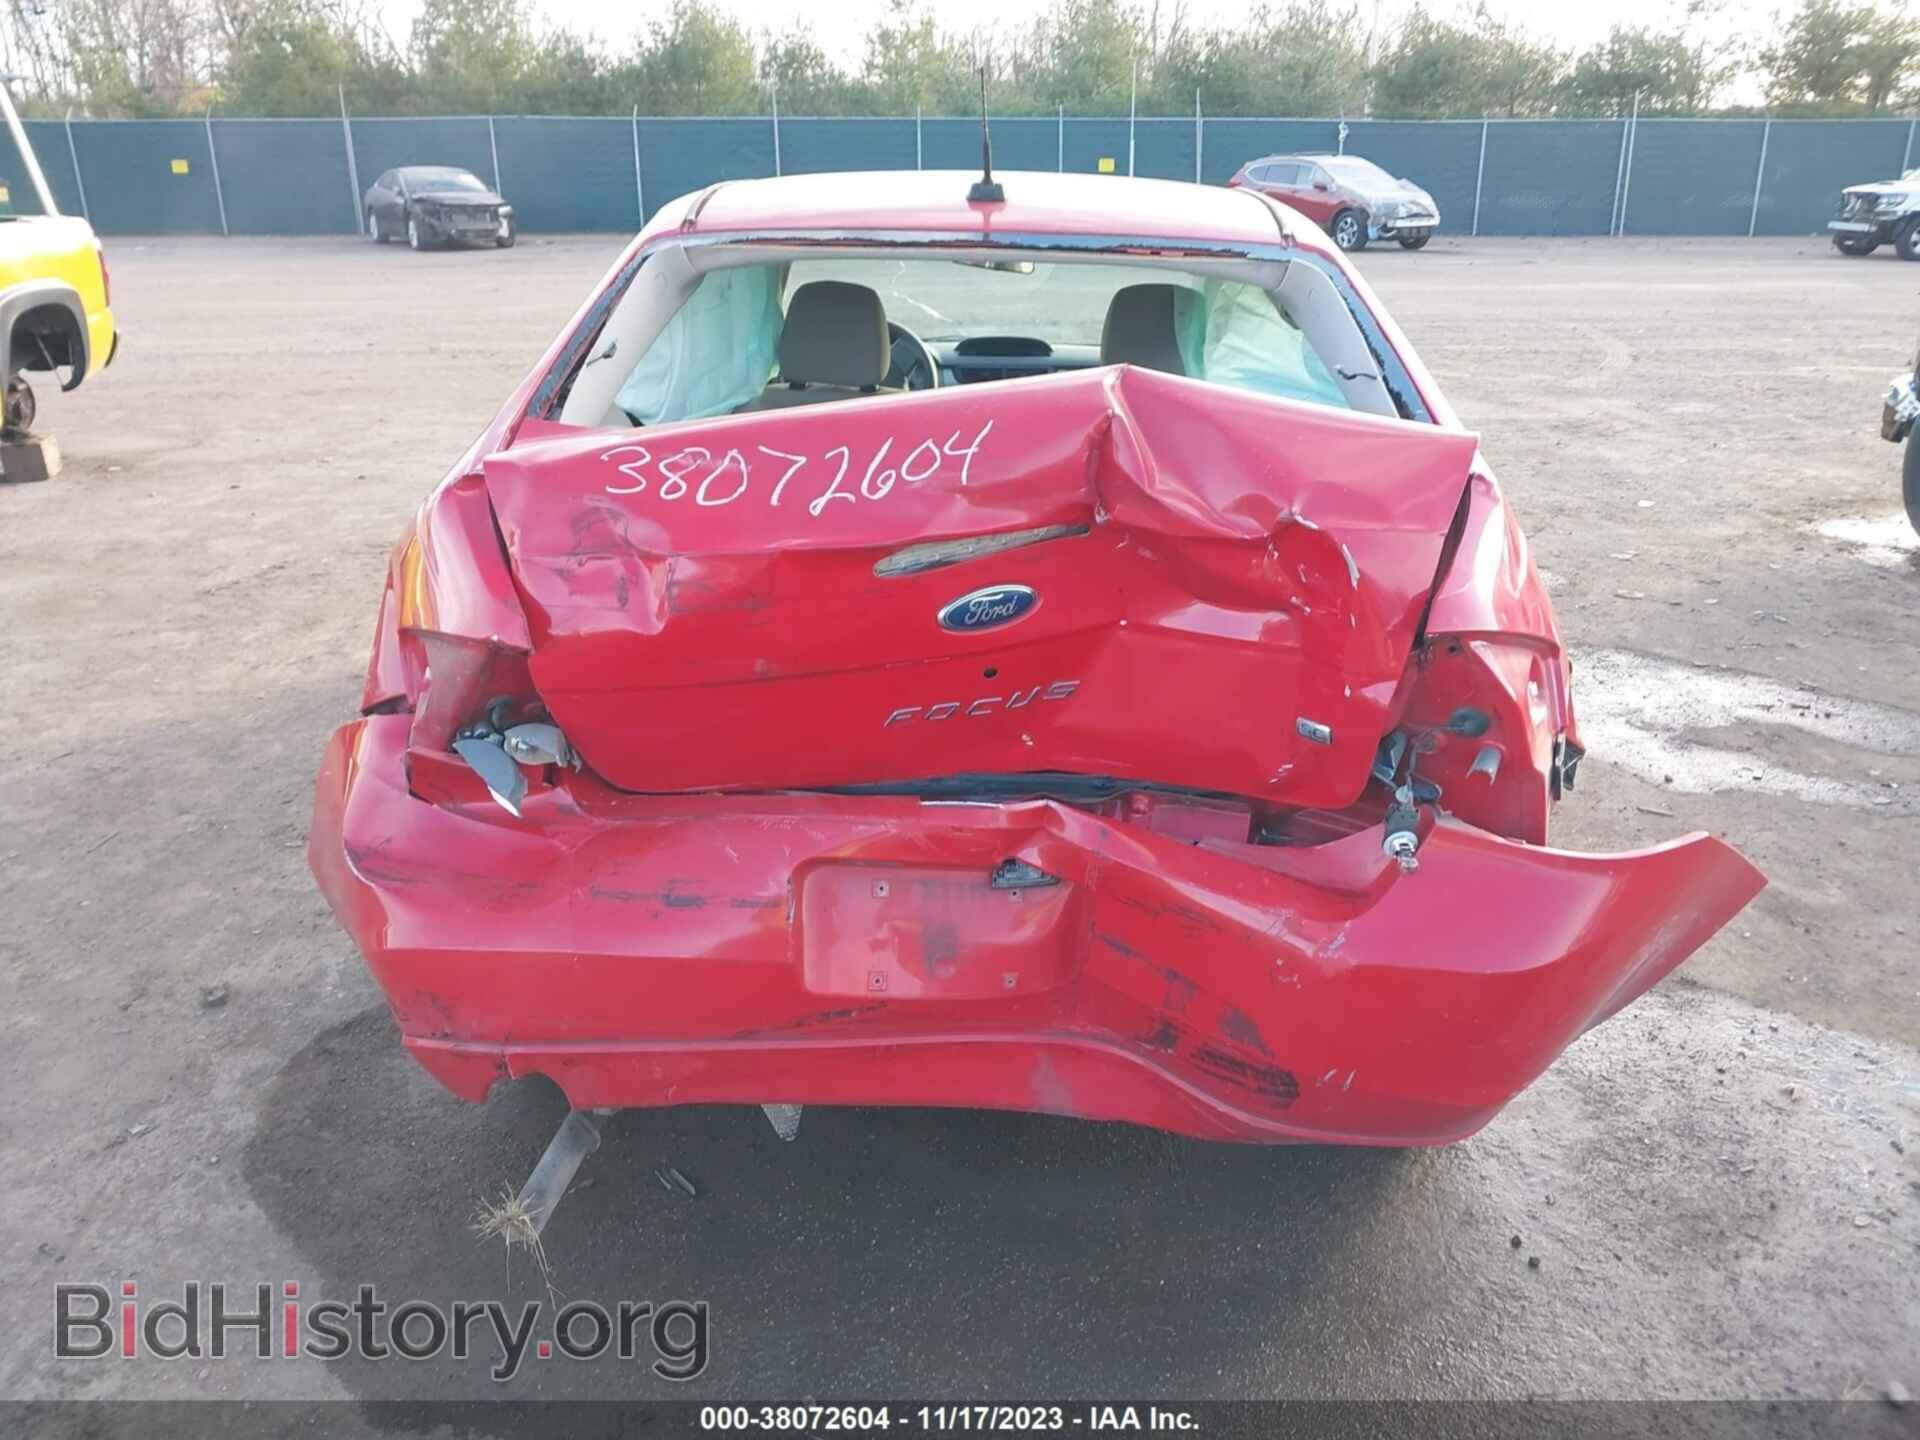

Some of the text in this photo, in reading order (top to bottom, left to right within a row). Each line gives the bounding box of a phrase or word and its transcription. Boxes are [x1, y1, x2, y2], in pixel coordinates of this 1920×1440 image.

[600, 419, 994, 516] 38072604
[963, 592, 1018, 625] Ford
[883, 680, 1081, 728] FOCUS
